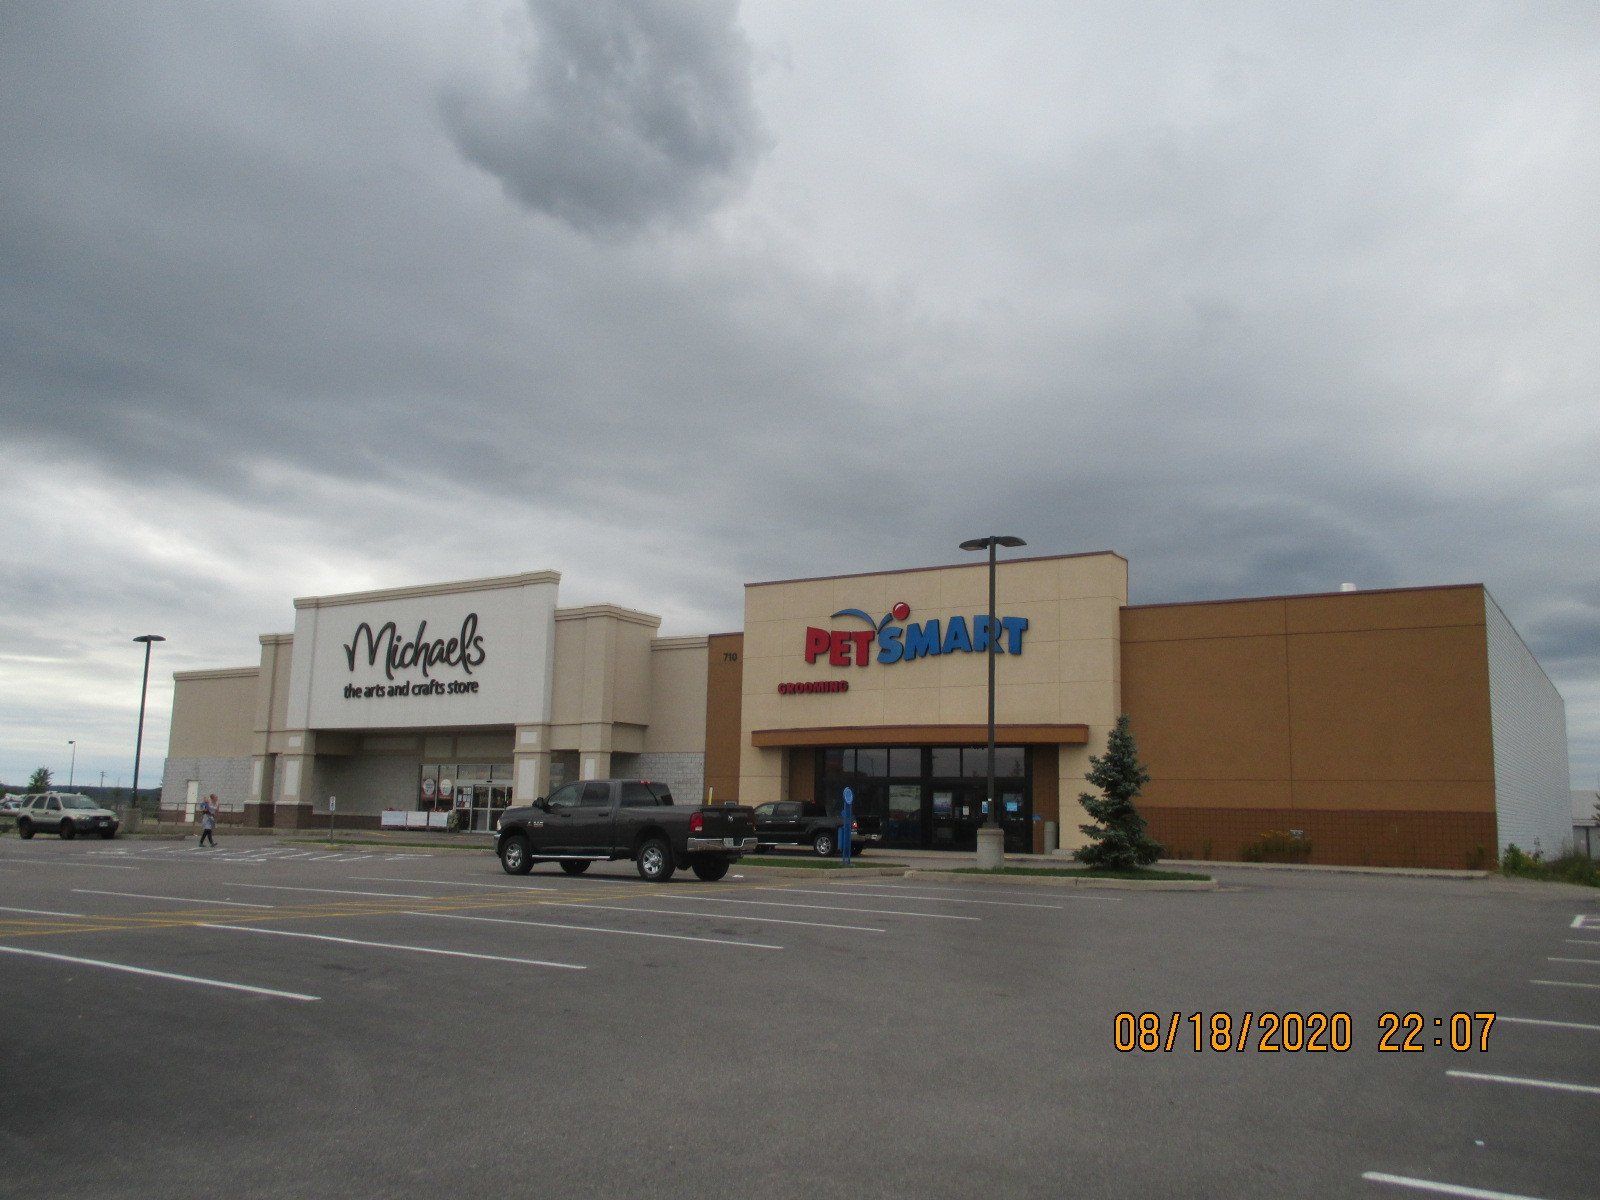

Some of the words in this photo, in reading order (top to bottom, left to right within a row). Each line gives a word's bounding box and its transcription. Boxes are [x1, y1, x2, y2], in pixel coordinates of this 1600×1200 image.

[343, 612, 486, 680] Michaels
[344, 683, 362, 698] the
[364, 684, 385, 697] arts
[387, 680, 410, 696] and
[412, 679, 445, 695] crafts
[447, 680, 479, 694] store
[777, 680, 849, 695] GROOMING
